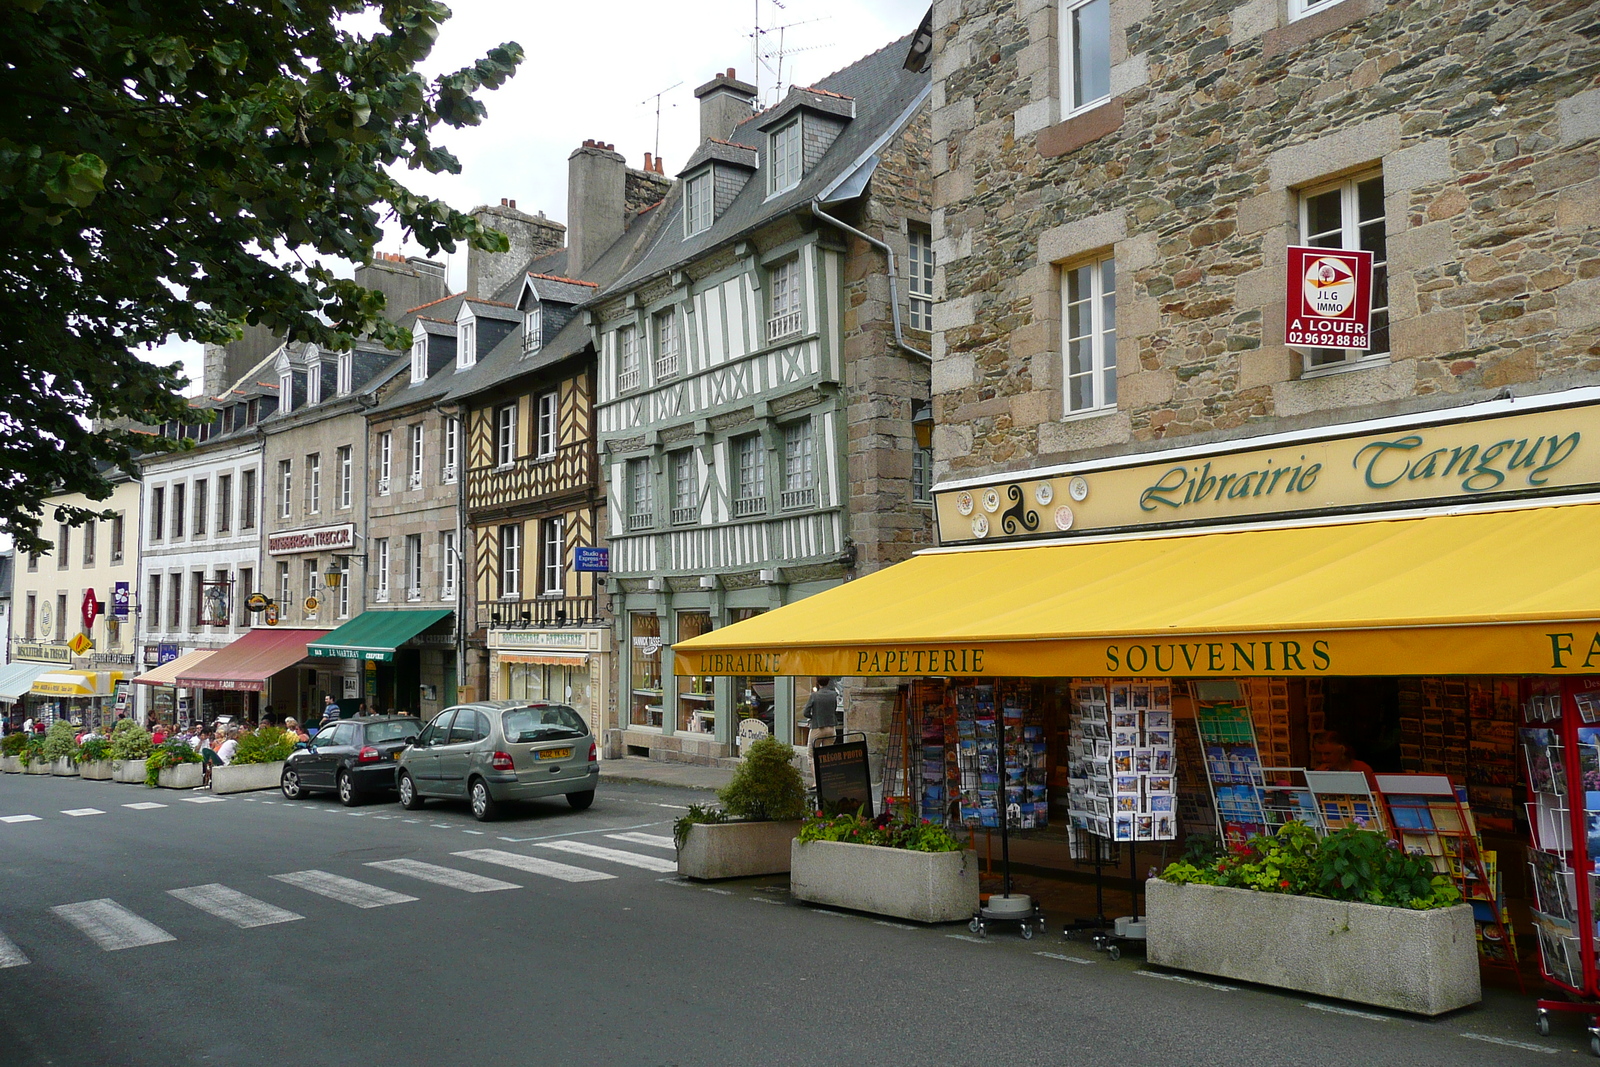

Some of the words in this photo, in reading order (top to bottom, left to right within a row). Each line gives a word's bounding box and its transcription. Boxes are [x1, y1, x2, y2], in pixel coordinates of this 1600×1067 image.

[1317, 302, 1343, 312] IMMO
[1290, 318, 1302, 330] A
[1309, 319, 1365, 334] LOUER
[1289, 331, 1303, 343] 02
[1304, 332, 1319, 344] 96
[1320, 333, 1335, 345] 92
[1336, 334, 1350, 346] 88
[1352, 335, 1367, 347] 88
[1139, 454, 1322, 511] Librairie
[1352, 431, 1581, 492] Tanguy
[328, 649, 336, 657] LE
[700, 653, 781, 673] LIBRAIRIE
[856, 649, 985, 673] PAPETERIE
[1105, 640, 1331, 672] SOUVENIRS
[345, 680, 356, 690] BAR
[843, 748, 863, 760] PHOTO
